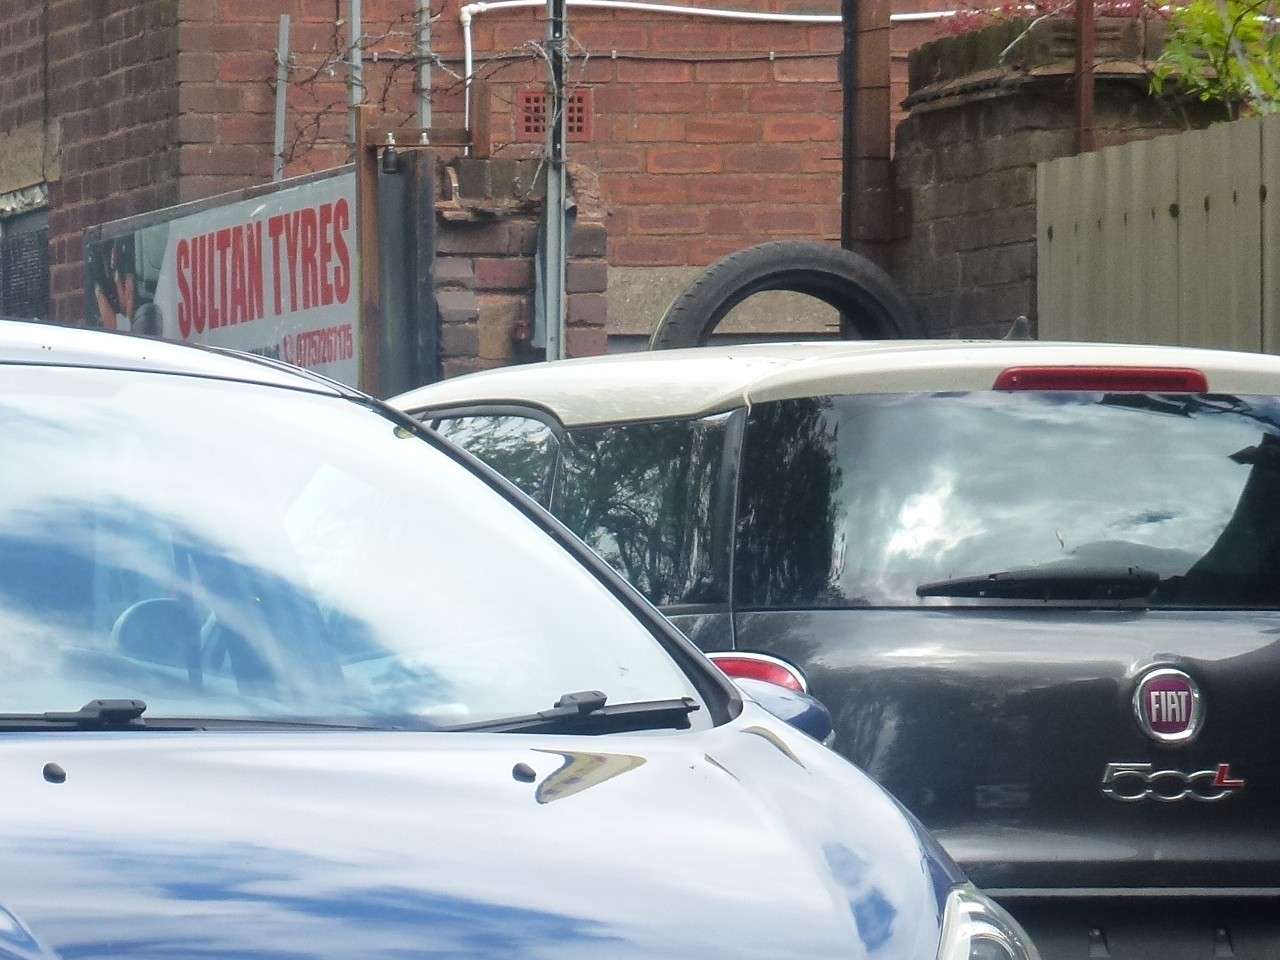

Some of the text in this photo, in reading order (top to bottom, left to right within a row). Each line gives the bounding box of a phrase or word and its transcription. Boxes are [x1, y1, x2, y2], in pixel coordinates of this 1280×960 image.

[176, 198, 351, 339] SULTAN TYRES
[1150, 691, 1189, 723] FIAT
[1102, 762, 1245, 802] 500L
